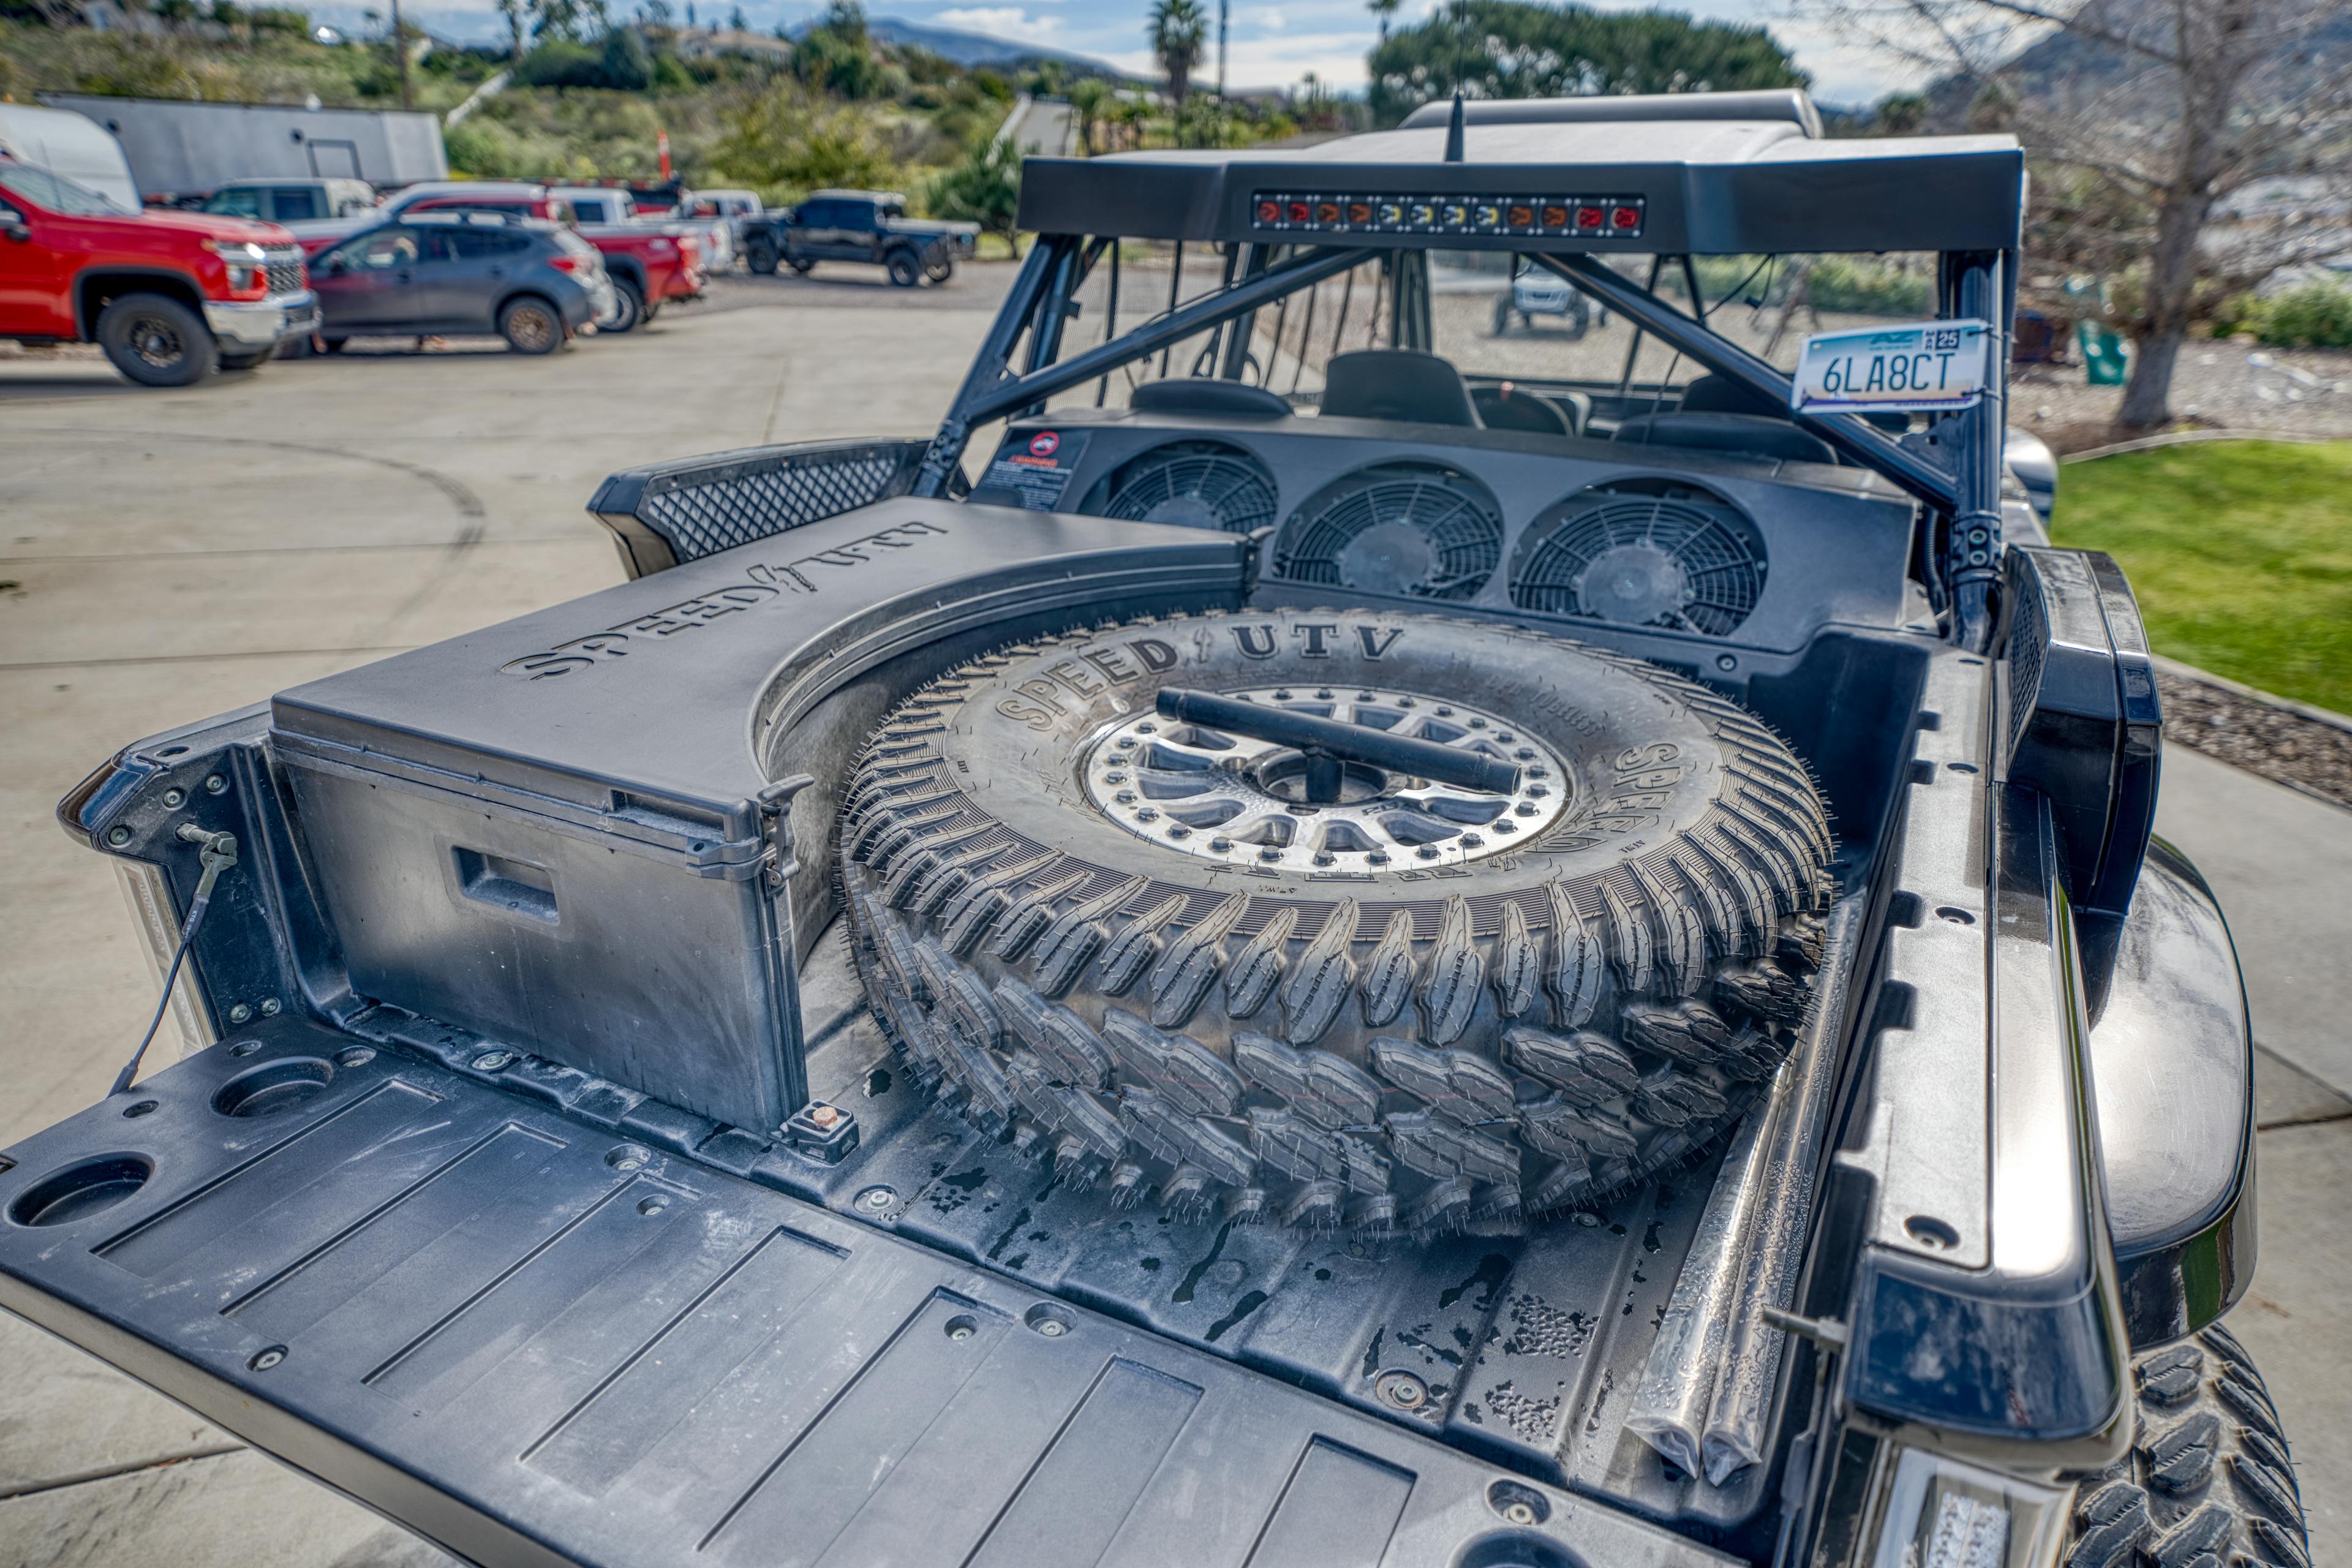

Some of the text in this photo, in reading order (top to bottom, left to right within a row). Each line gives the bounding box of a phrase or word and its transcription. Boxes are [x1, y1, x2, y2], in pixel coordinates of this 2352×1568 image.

[1823, 352, 1955, 393] 6LA8CT
[1937, 331, 1958, 349] 25
[501, 584, 780, 680] SPEED
[995, 624, 1404, 732] SPEED UTV
